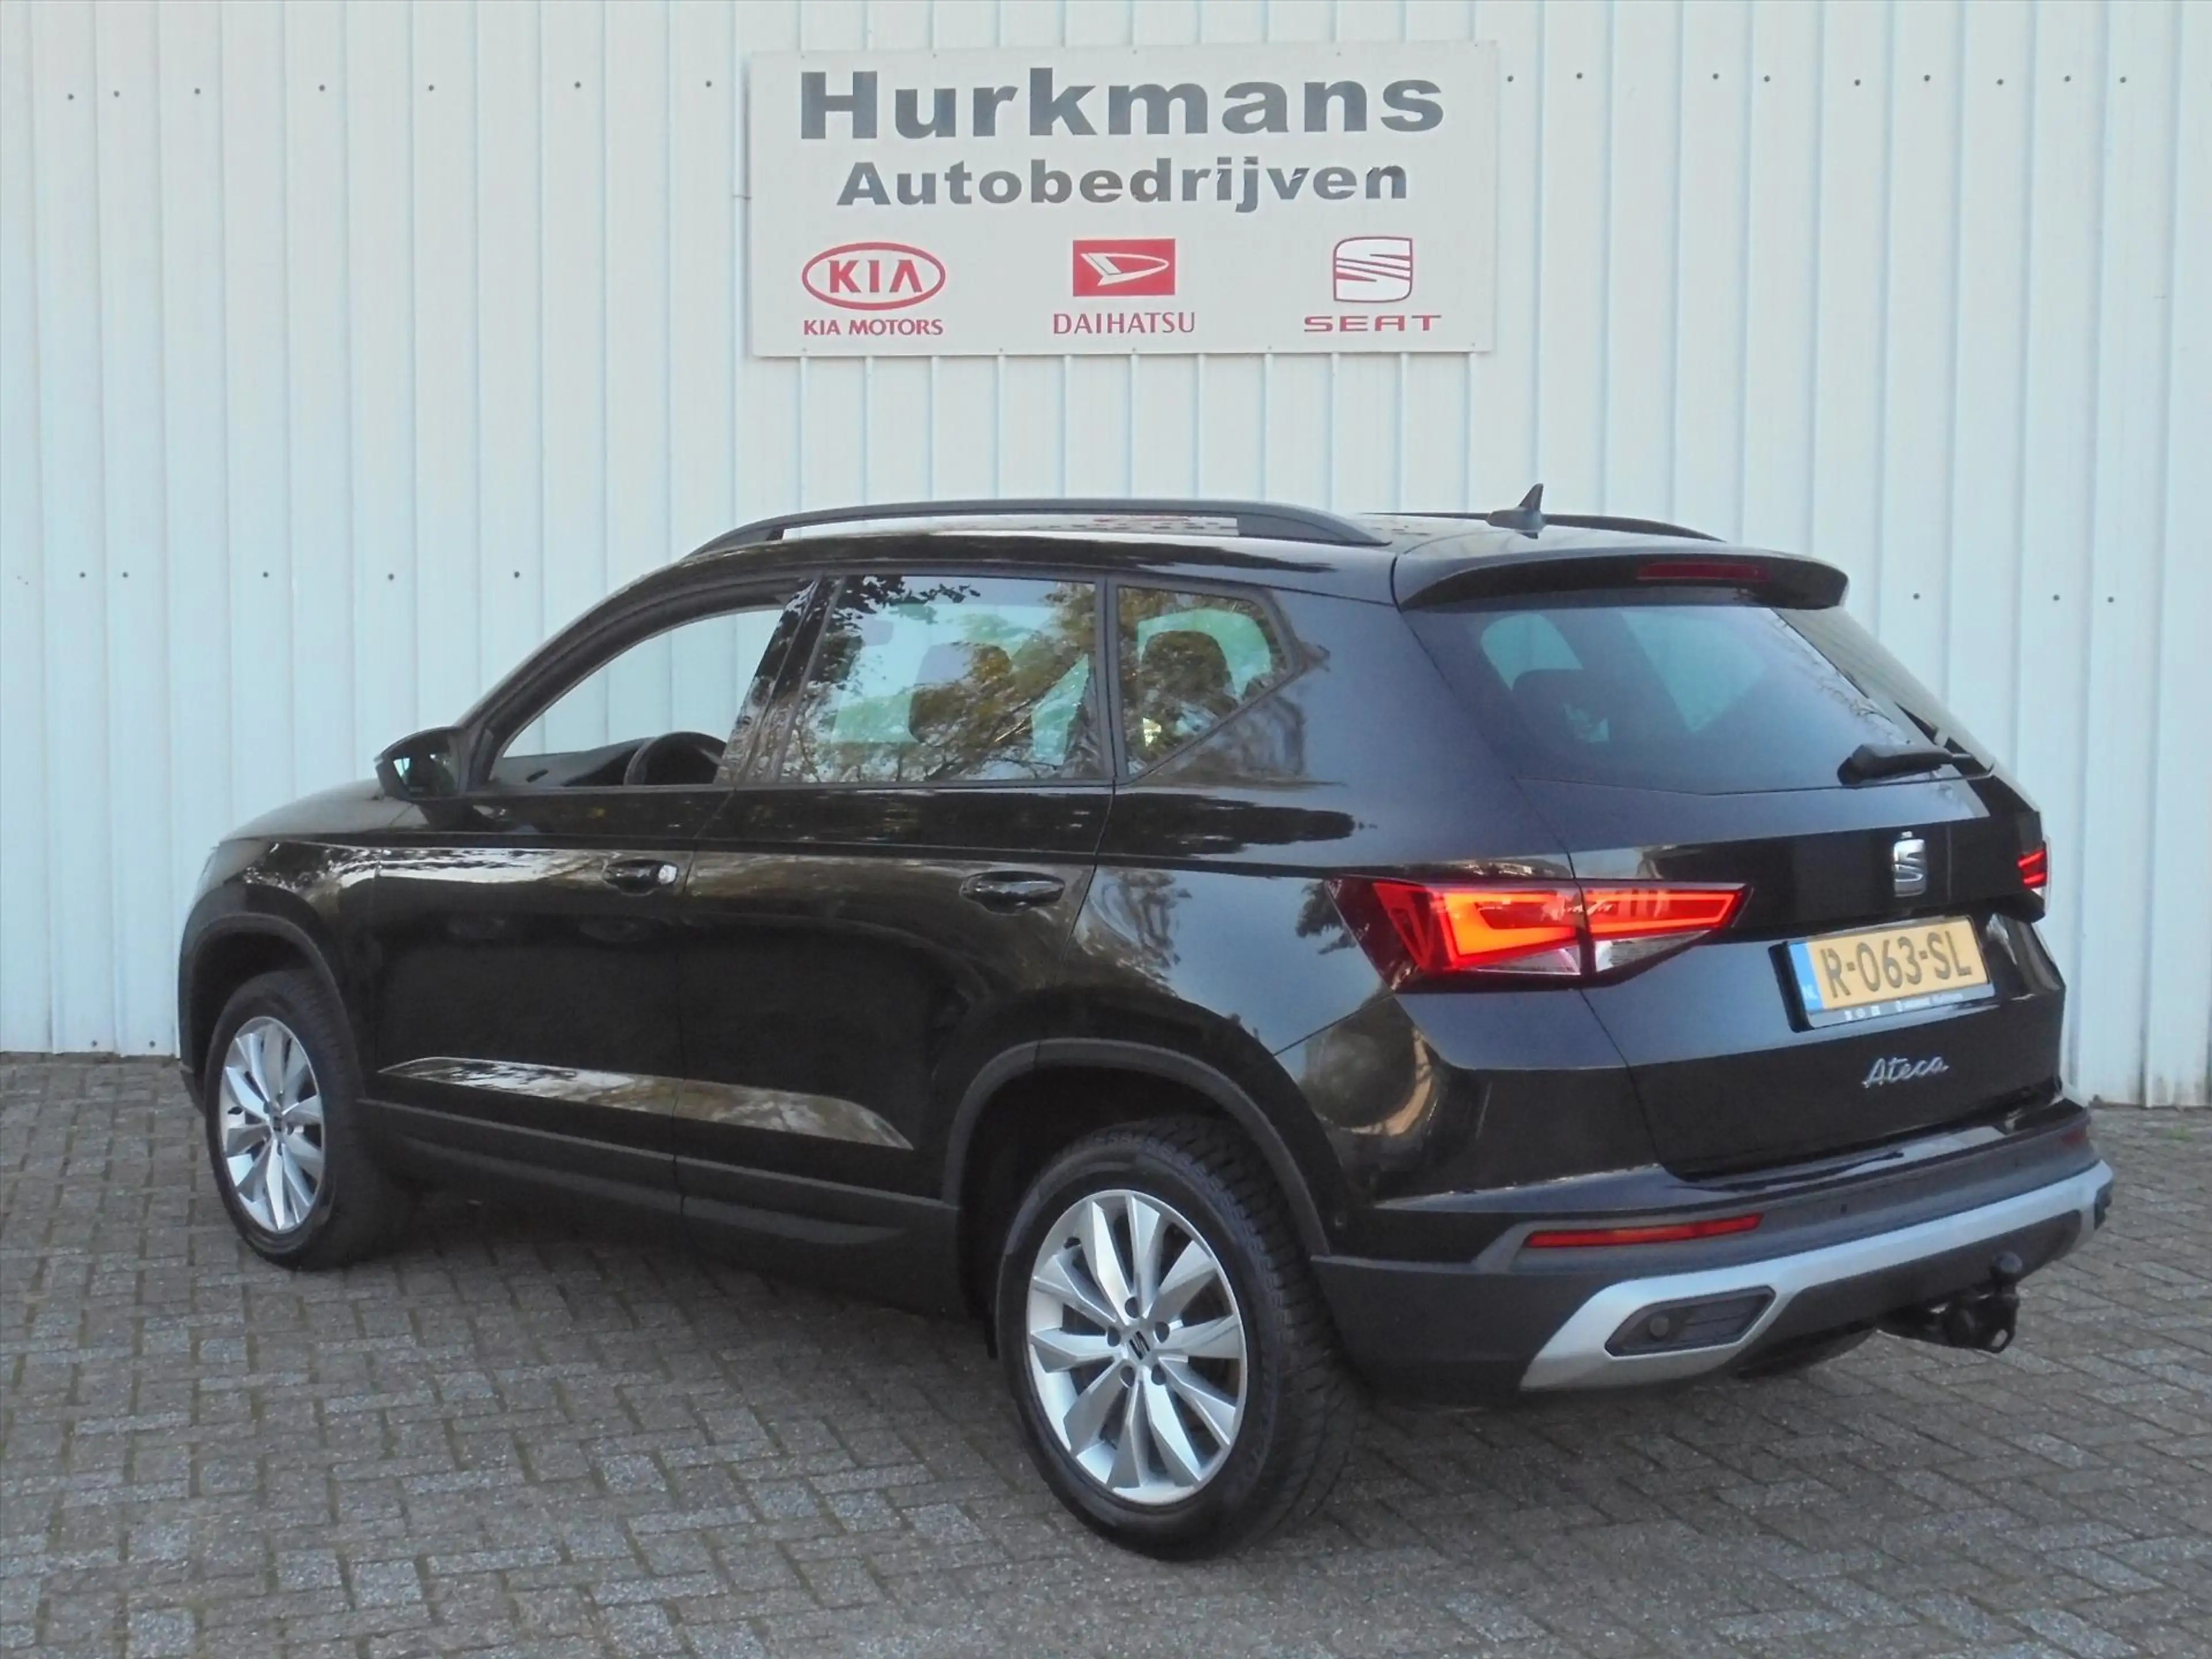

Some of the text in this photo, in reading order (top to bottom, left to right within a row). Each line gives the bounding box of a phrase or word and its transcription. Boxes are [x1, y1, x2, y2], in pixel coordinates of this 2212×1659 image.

[801, 67, 1444, 139] Hurkmans
[836, 156, 1407, 213] Autobedrijven
[828, 259, 923, 294] KIA
[804, 319, 944, 336] KIA MOTORS
[1053, 312, 1196, 334] DAIHATSU
[1304, 315, 1442, 332] SEAT
[1820, 930, 1972, 999] R-063-SL
[1861, 1056, 1949, 1088] Ateca
